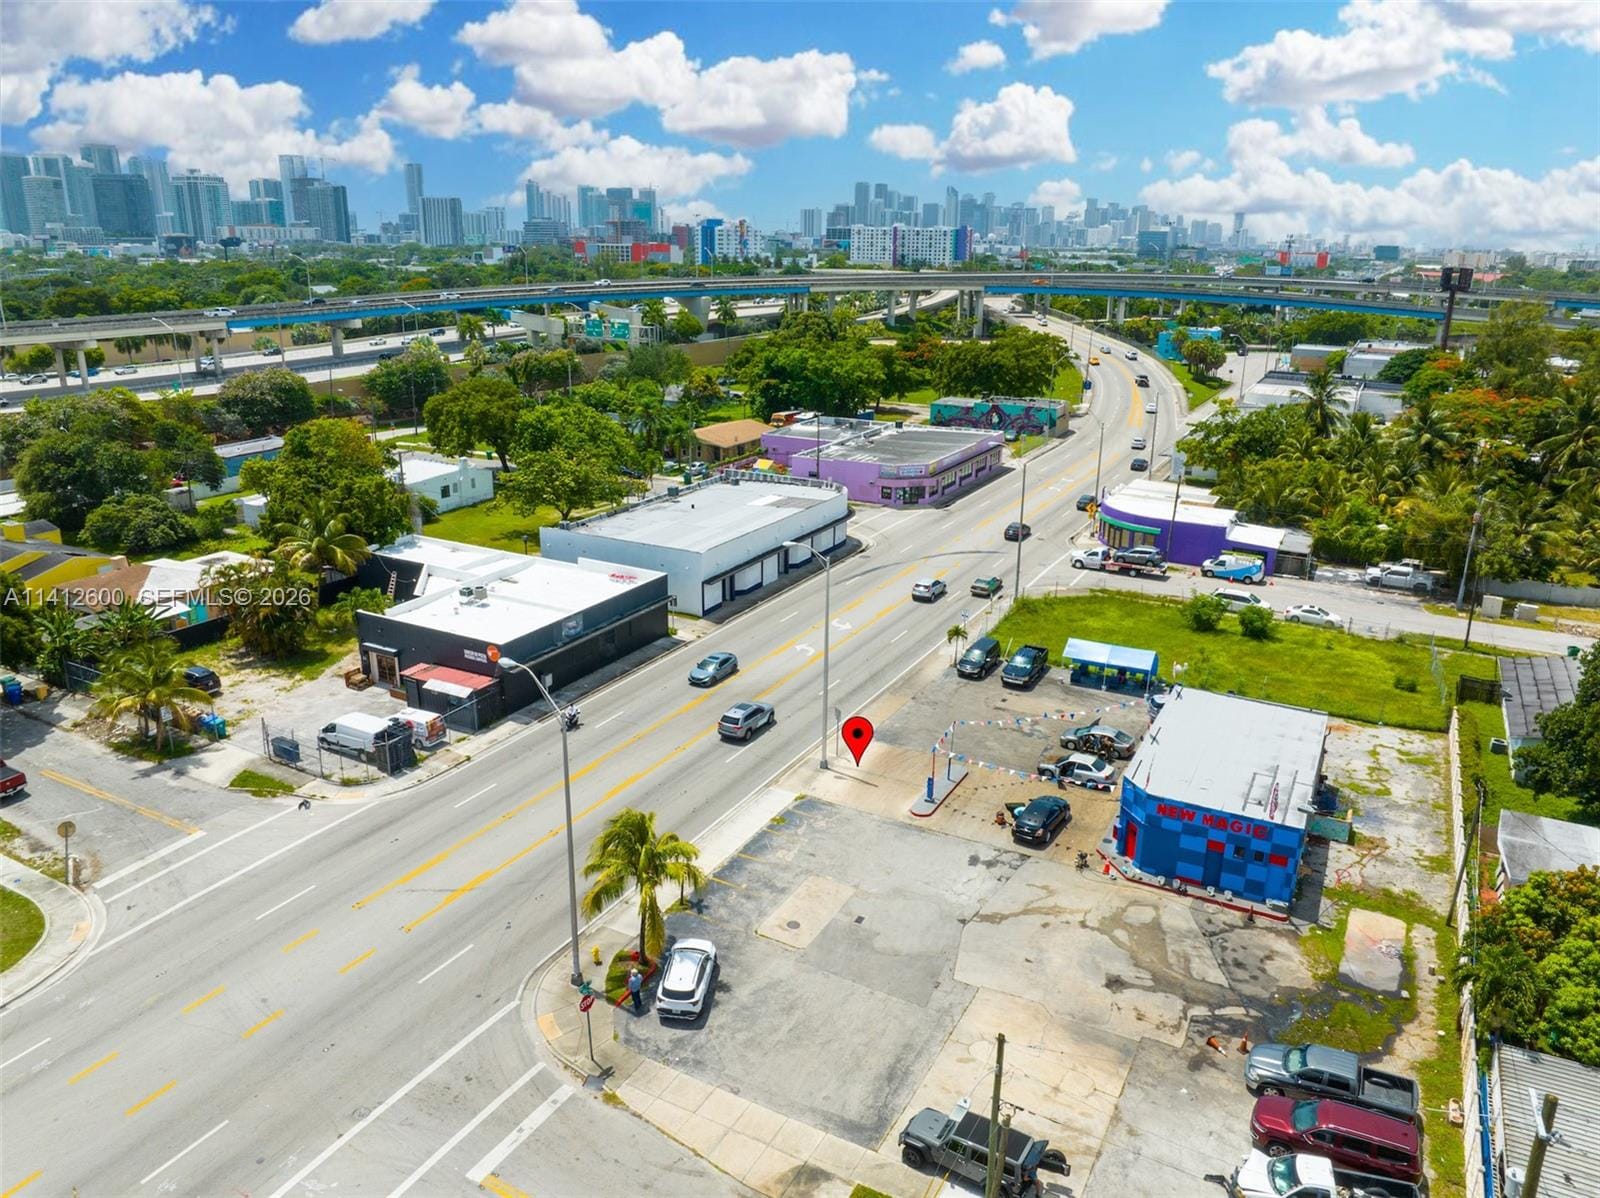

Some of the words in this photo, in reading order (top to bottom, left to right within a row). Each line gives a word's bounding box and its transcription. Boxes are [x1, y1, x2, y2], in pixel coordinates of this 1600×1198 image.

[1156, 803, 1197, 822] NEW
[1202, 813, 1269, 839] MAGIC
[580, 996, 594, 1010] STOP
